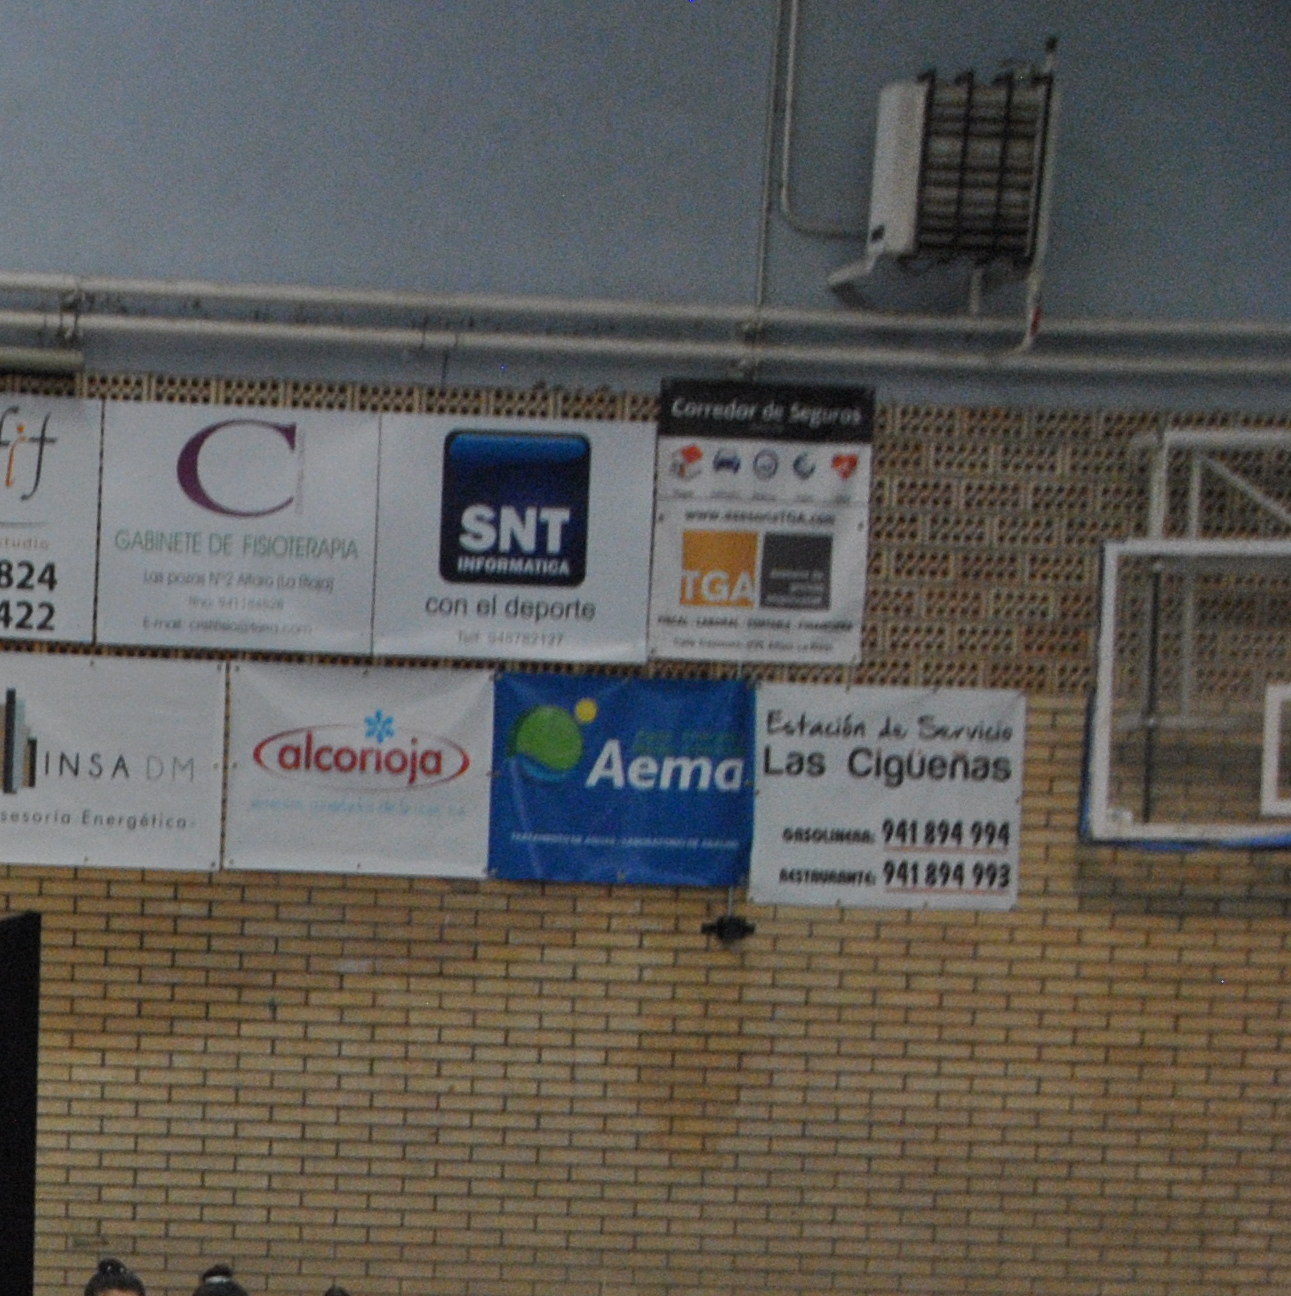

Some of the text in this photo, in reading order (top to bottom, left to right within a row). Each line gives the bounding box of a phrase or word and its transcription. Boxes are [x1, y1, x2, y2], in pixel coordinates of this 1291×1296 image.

[671, 398, 861, 428] Corredor de Seguros
[176, 418, 297, 518] C
[113, 529, 358, 560] GABINETE DE FISIOTERAPIA
[458, 503, 570, 555] SNT
[683, 570, 755, 602] TGA
[425, 595, 596, 622] con el deporte
[766, 709, 1013, 743] Estación de Servicio
[44, 751, 195, 783] INSA DM
[585, 738, 745, 792] Aema
[763, 745, 1013, 788] Las Cigüeñas
[882, 818, 918, 846] 941
[924, 819, 964, 847] 894
[971, 820, 1011, 847] 994
[883, 859, 919, 887] 941
[925, 861, 965, 888] 894
[972, 862, 1011, 889] 993
